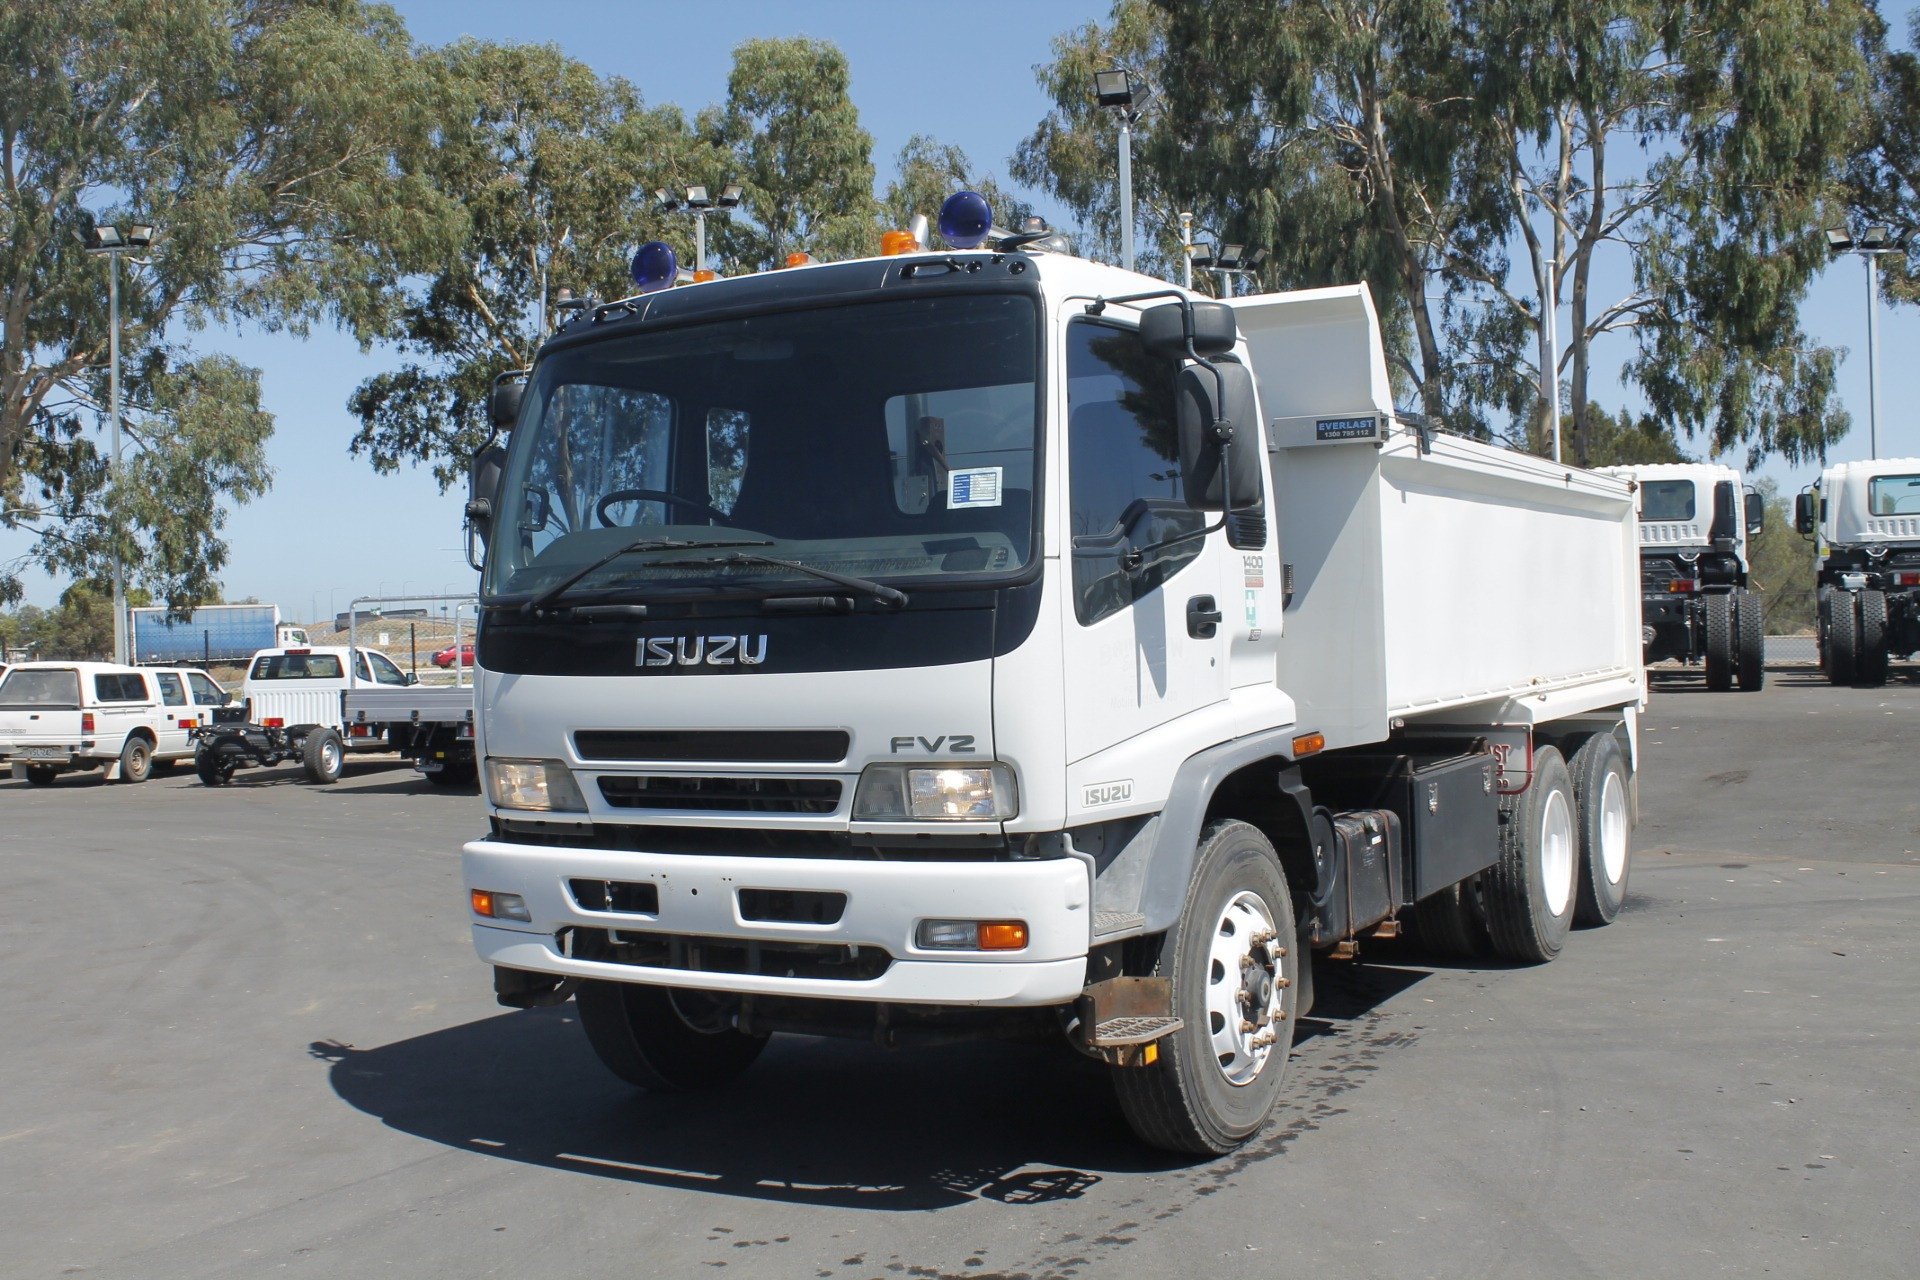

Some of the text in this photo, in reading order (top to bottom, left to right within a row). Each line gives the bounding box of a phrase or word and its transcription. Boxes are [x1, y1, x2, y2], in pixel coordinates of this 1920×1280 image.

[1318, 420, 1374, 431] EVERLAST
[1242, 555, 1264, 569] 1400
[635, 634, 768, 667] ISUZU
[1085, 783, 1132, 805] ISUZU
